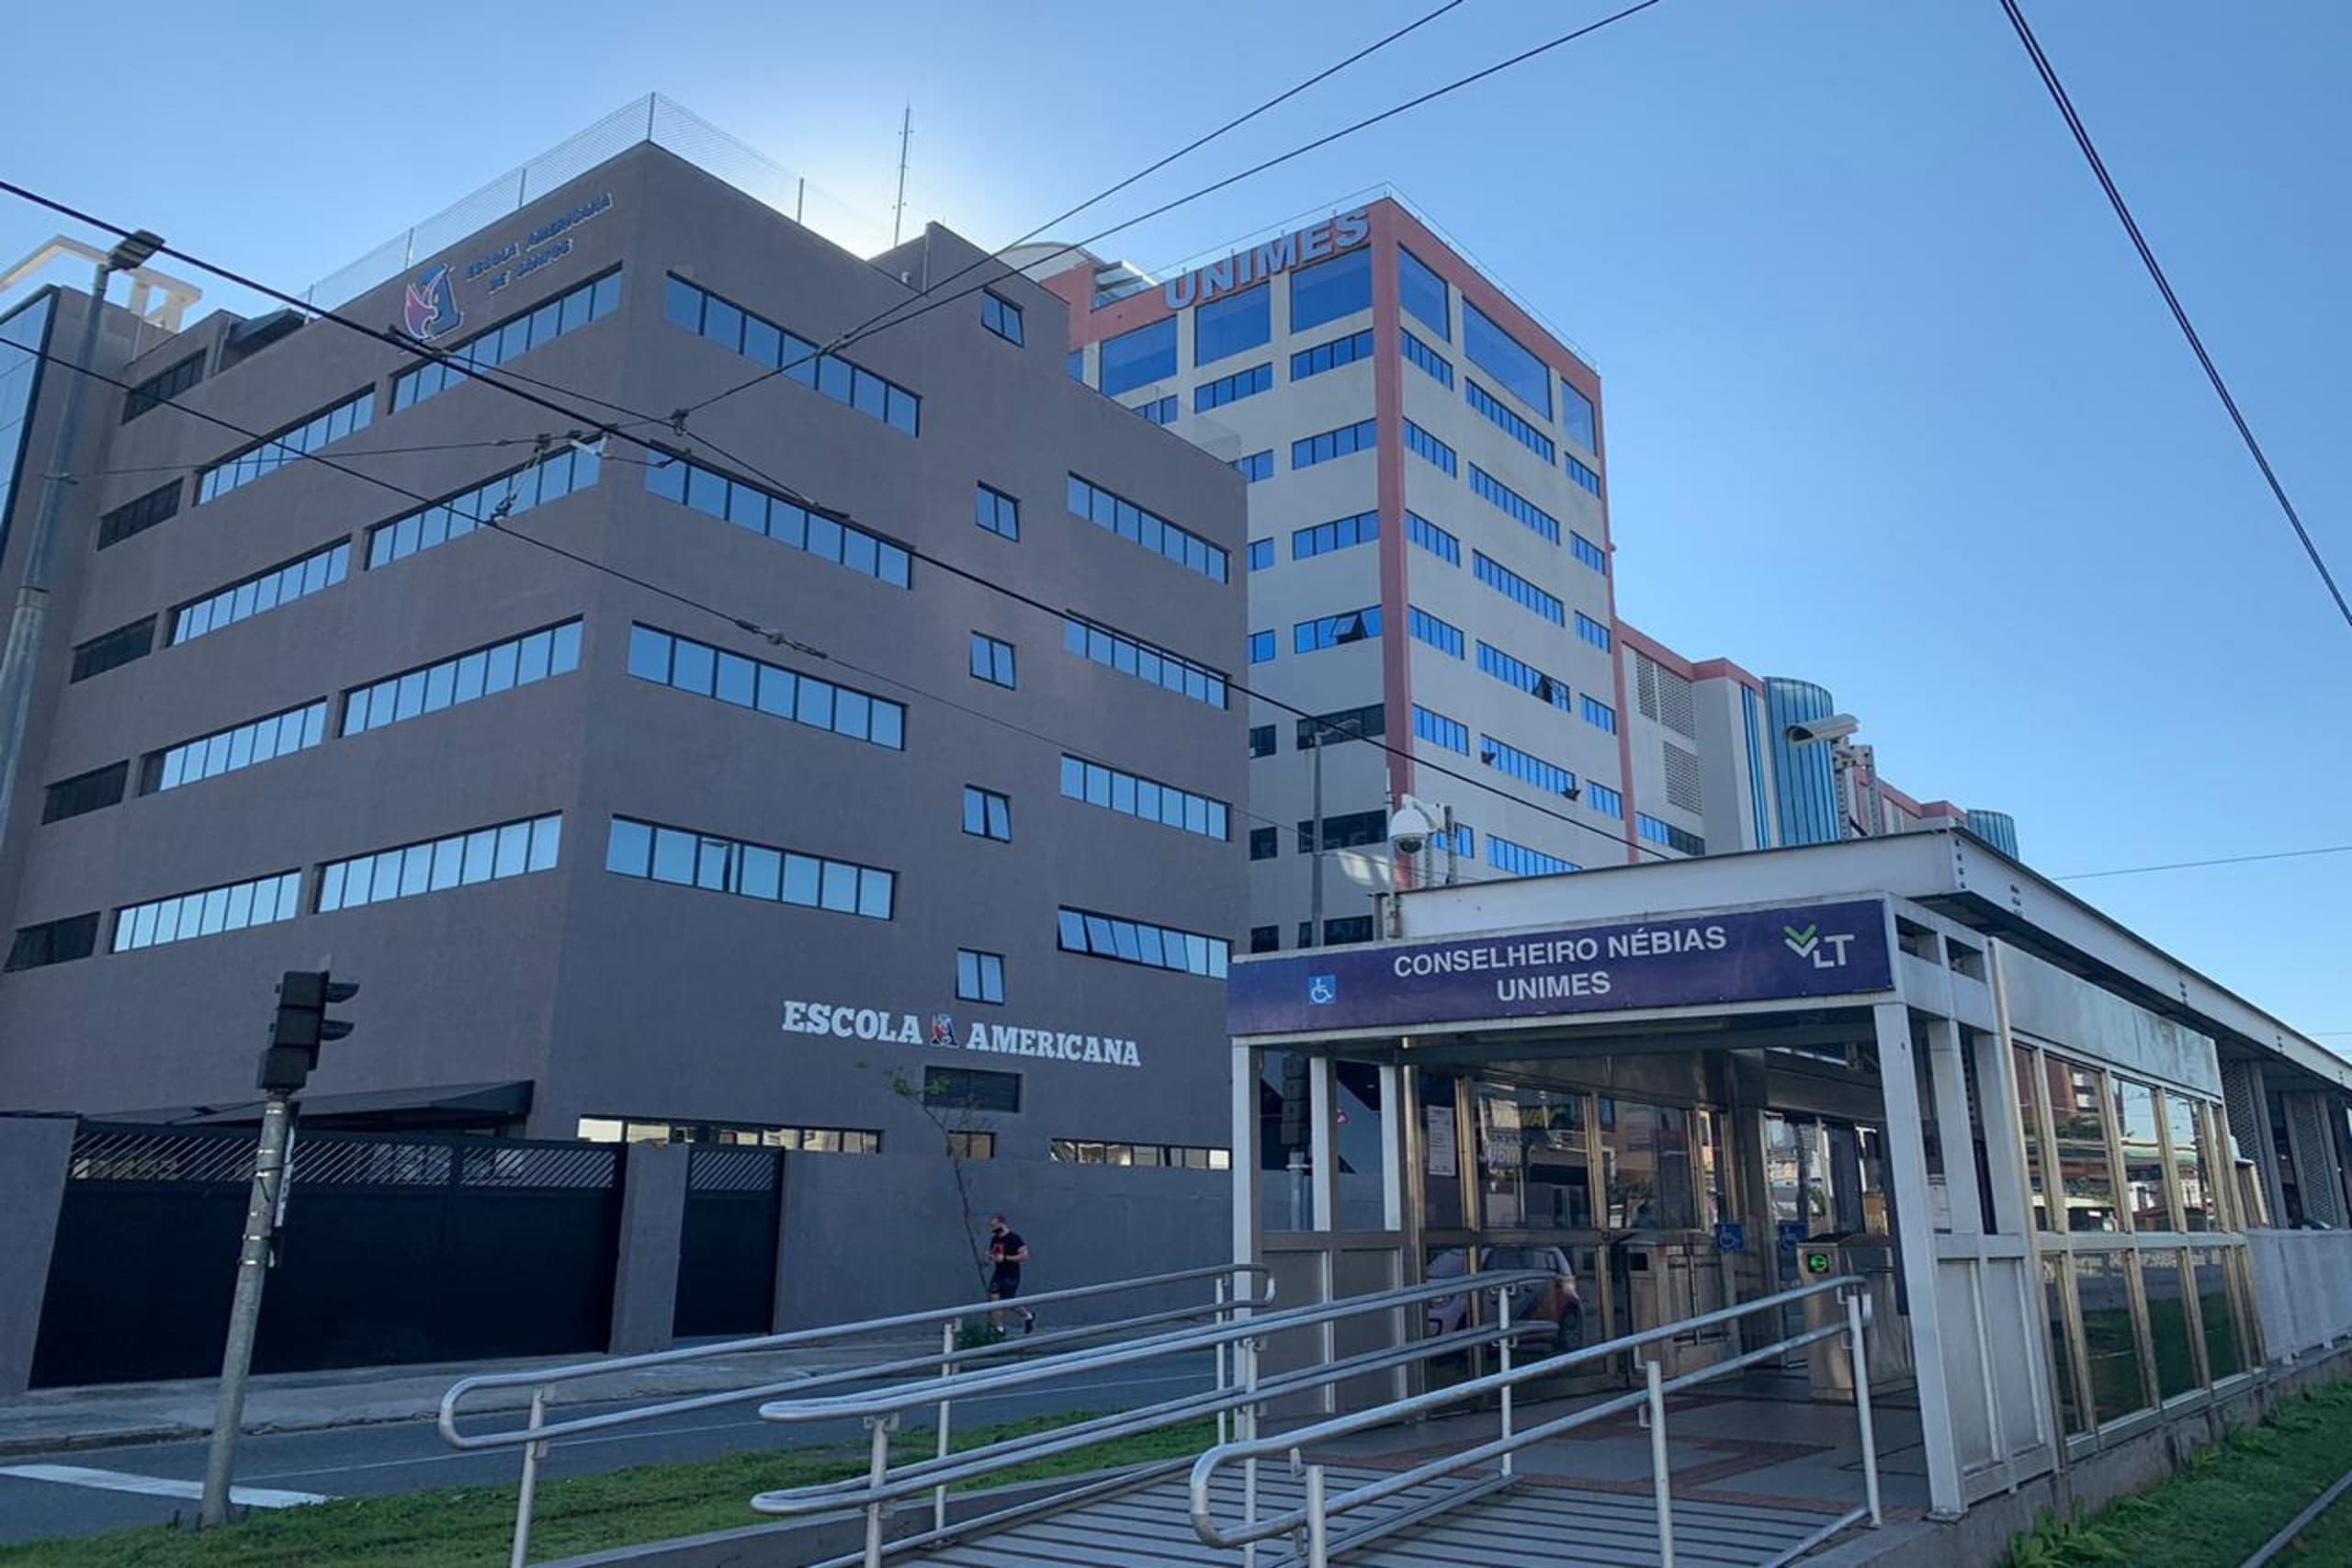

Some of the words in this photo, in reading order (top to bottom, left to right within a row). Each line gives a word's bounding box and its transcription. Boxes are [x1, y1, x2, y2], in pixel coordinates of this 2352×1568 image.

[1164, 210, 1372, 310] UNIMES
[1394, 937, 1599, 977] CONSELHEIRO
[1609, 925, 1727, 959] NÉBIAS
[1783, 923, 1855, 968] VLT
[1497, 970, 1611, 1001] UNIMES
[782, 1000, 923, 1044] ESCOLA
[967, 1021, 1141, 1067] AMERICANA
